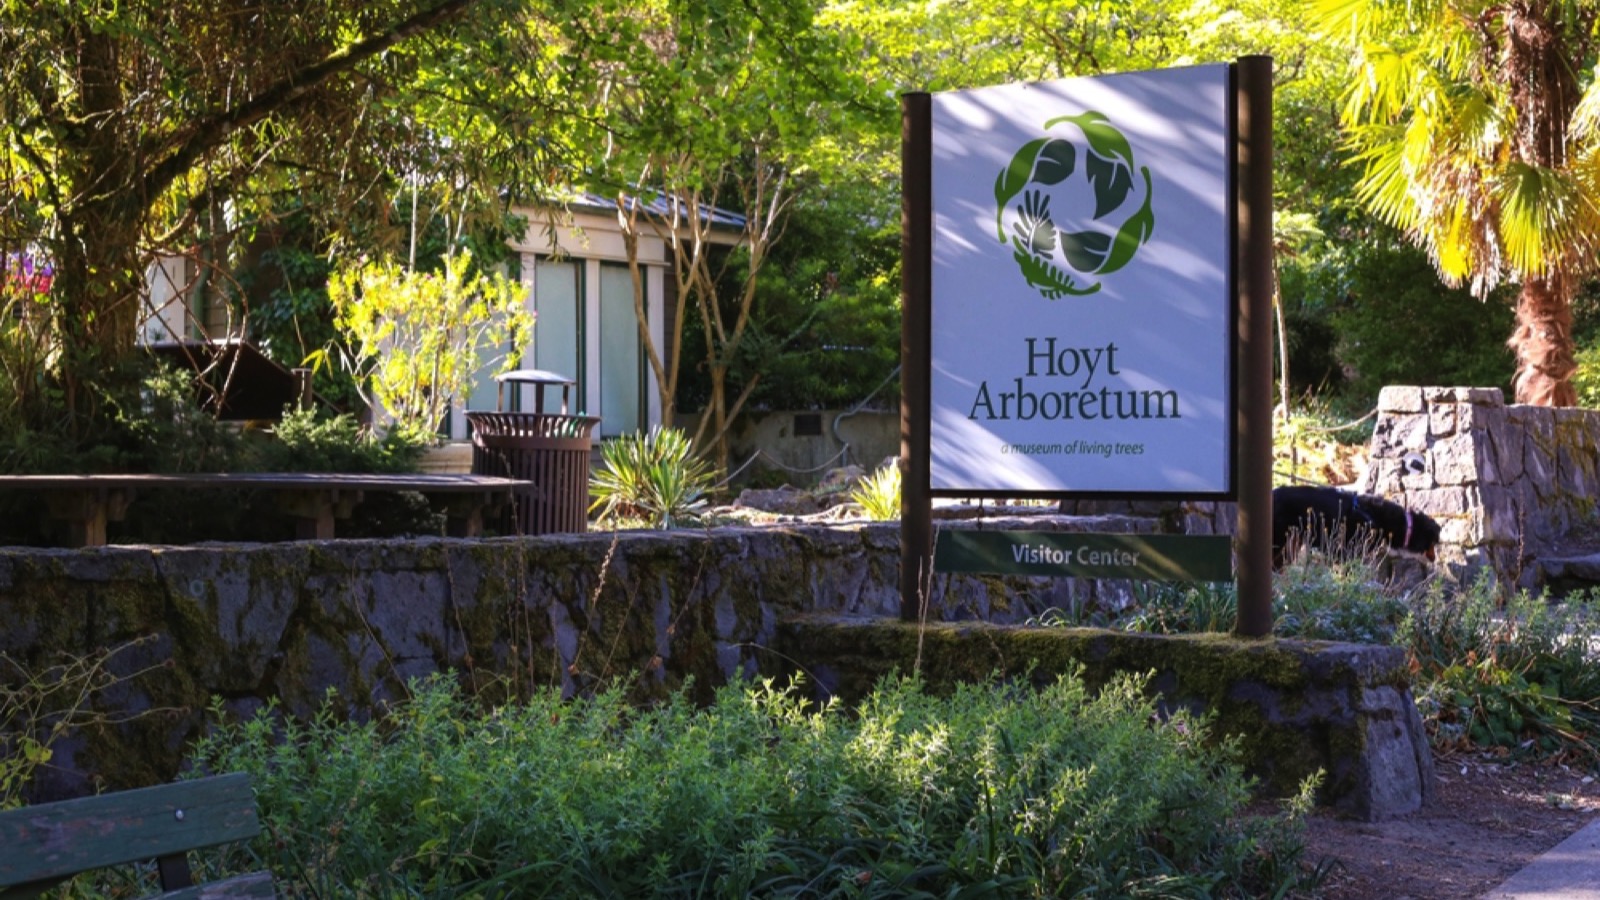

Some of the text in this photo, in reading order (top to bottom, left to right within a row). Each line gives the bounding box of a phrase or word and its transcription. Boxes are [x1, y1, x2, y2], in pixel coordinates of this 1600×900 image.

[1024, 337, 1120, 390] Hoyt
[967, 378, 1182, 420] Arboretum
[1000, 440, 1144, 458] a museum of living trees
[1011, 544, 1140, 567] Visitor Center
